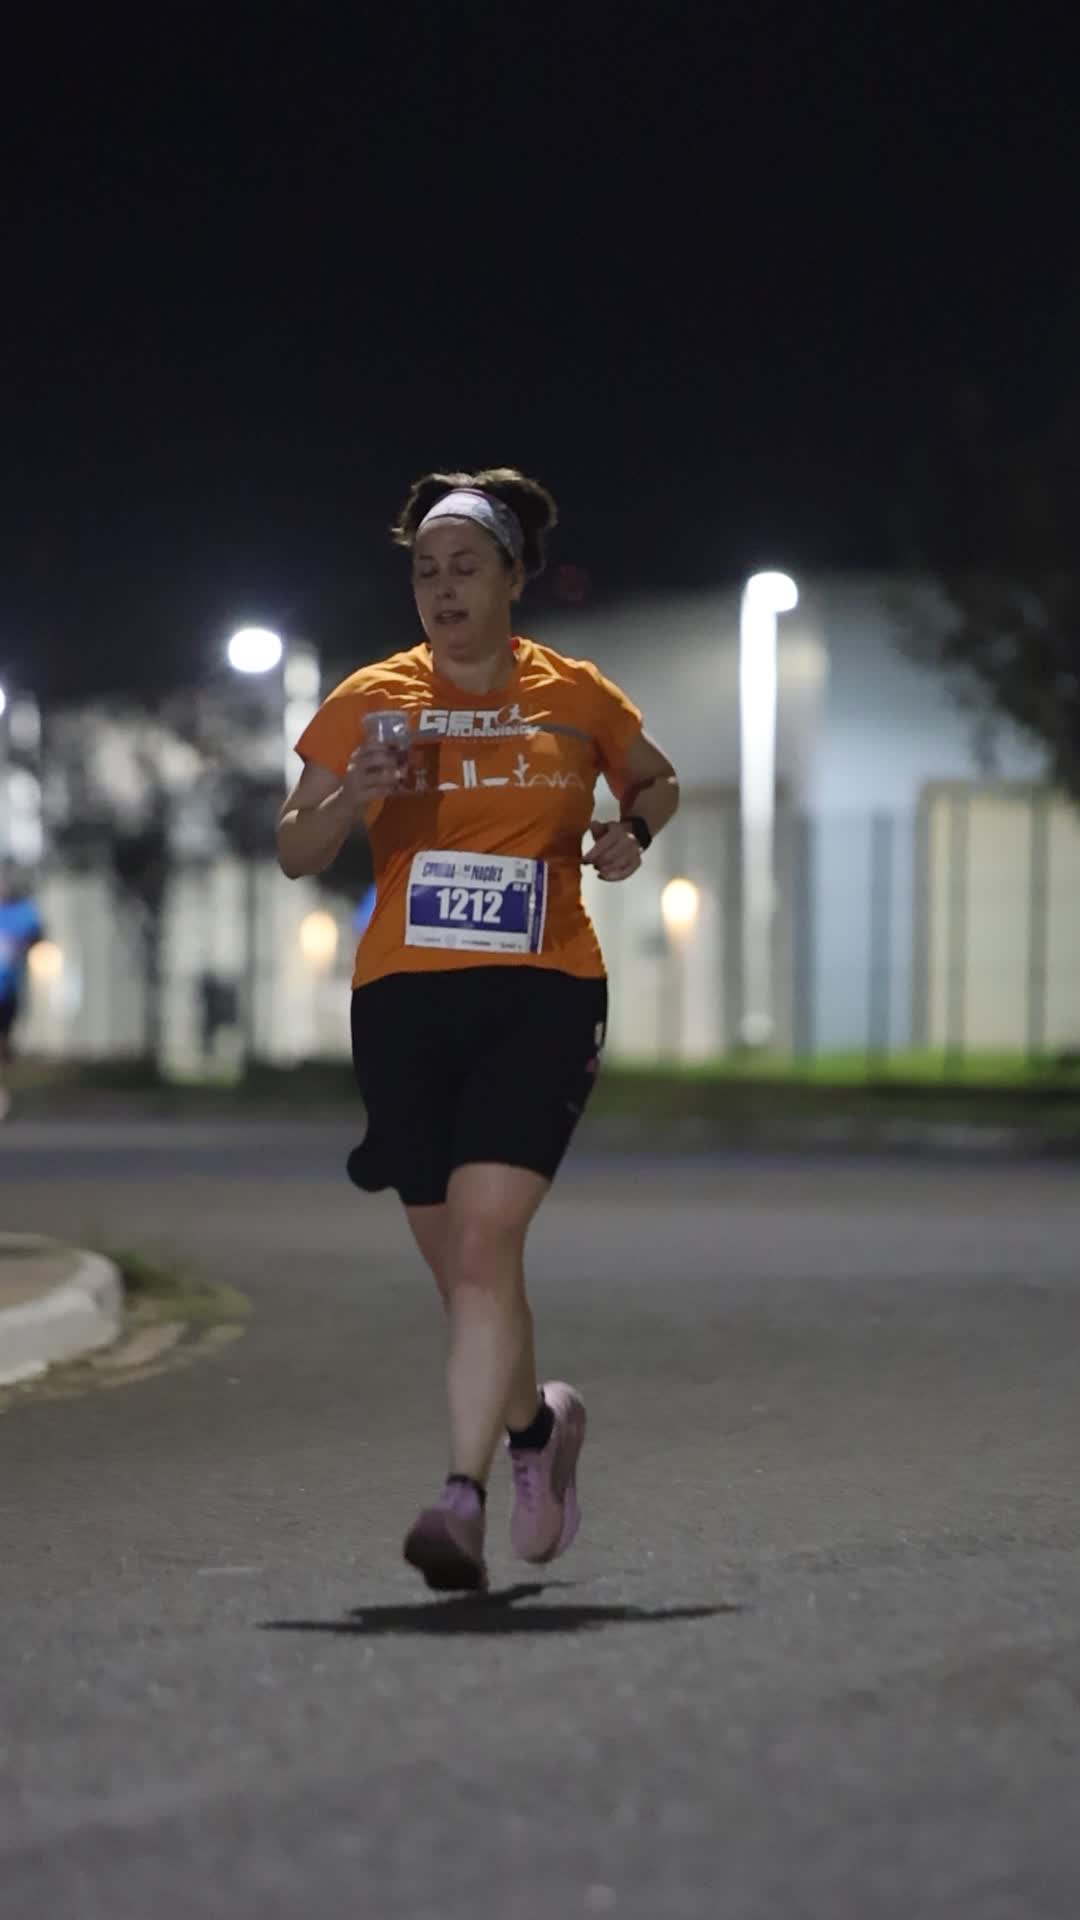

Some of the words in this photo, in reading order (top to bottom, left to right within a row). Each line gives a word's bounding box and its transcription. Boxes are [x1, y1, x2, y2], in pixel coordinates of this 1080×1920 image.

[419, 709, 498, 733] GET
[446, 724, 535, 737] RUNNING
[436, 887, 503, 923] 1212
